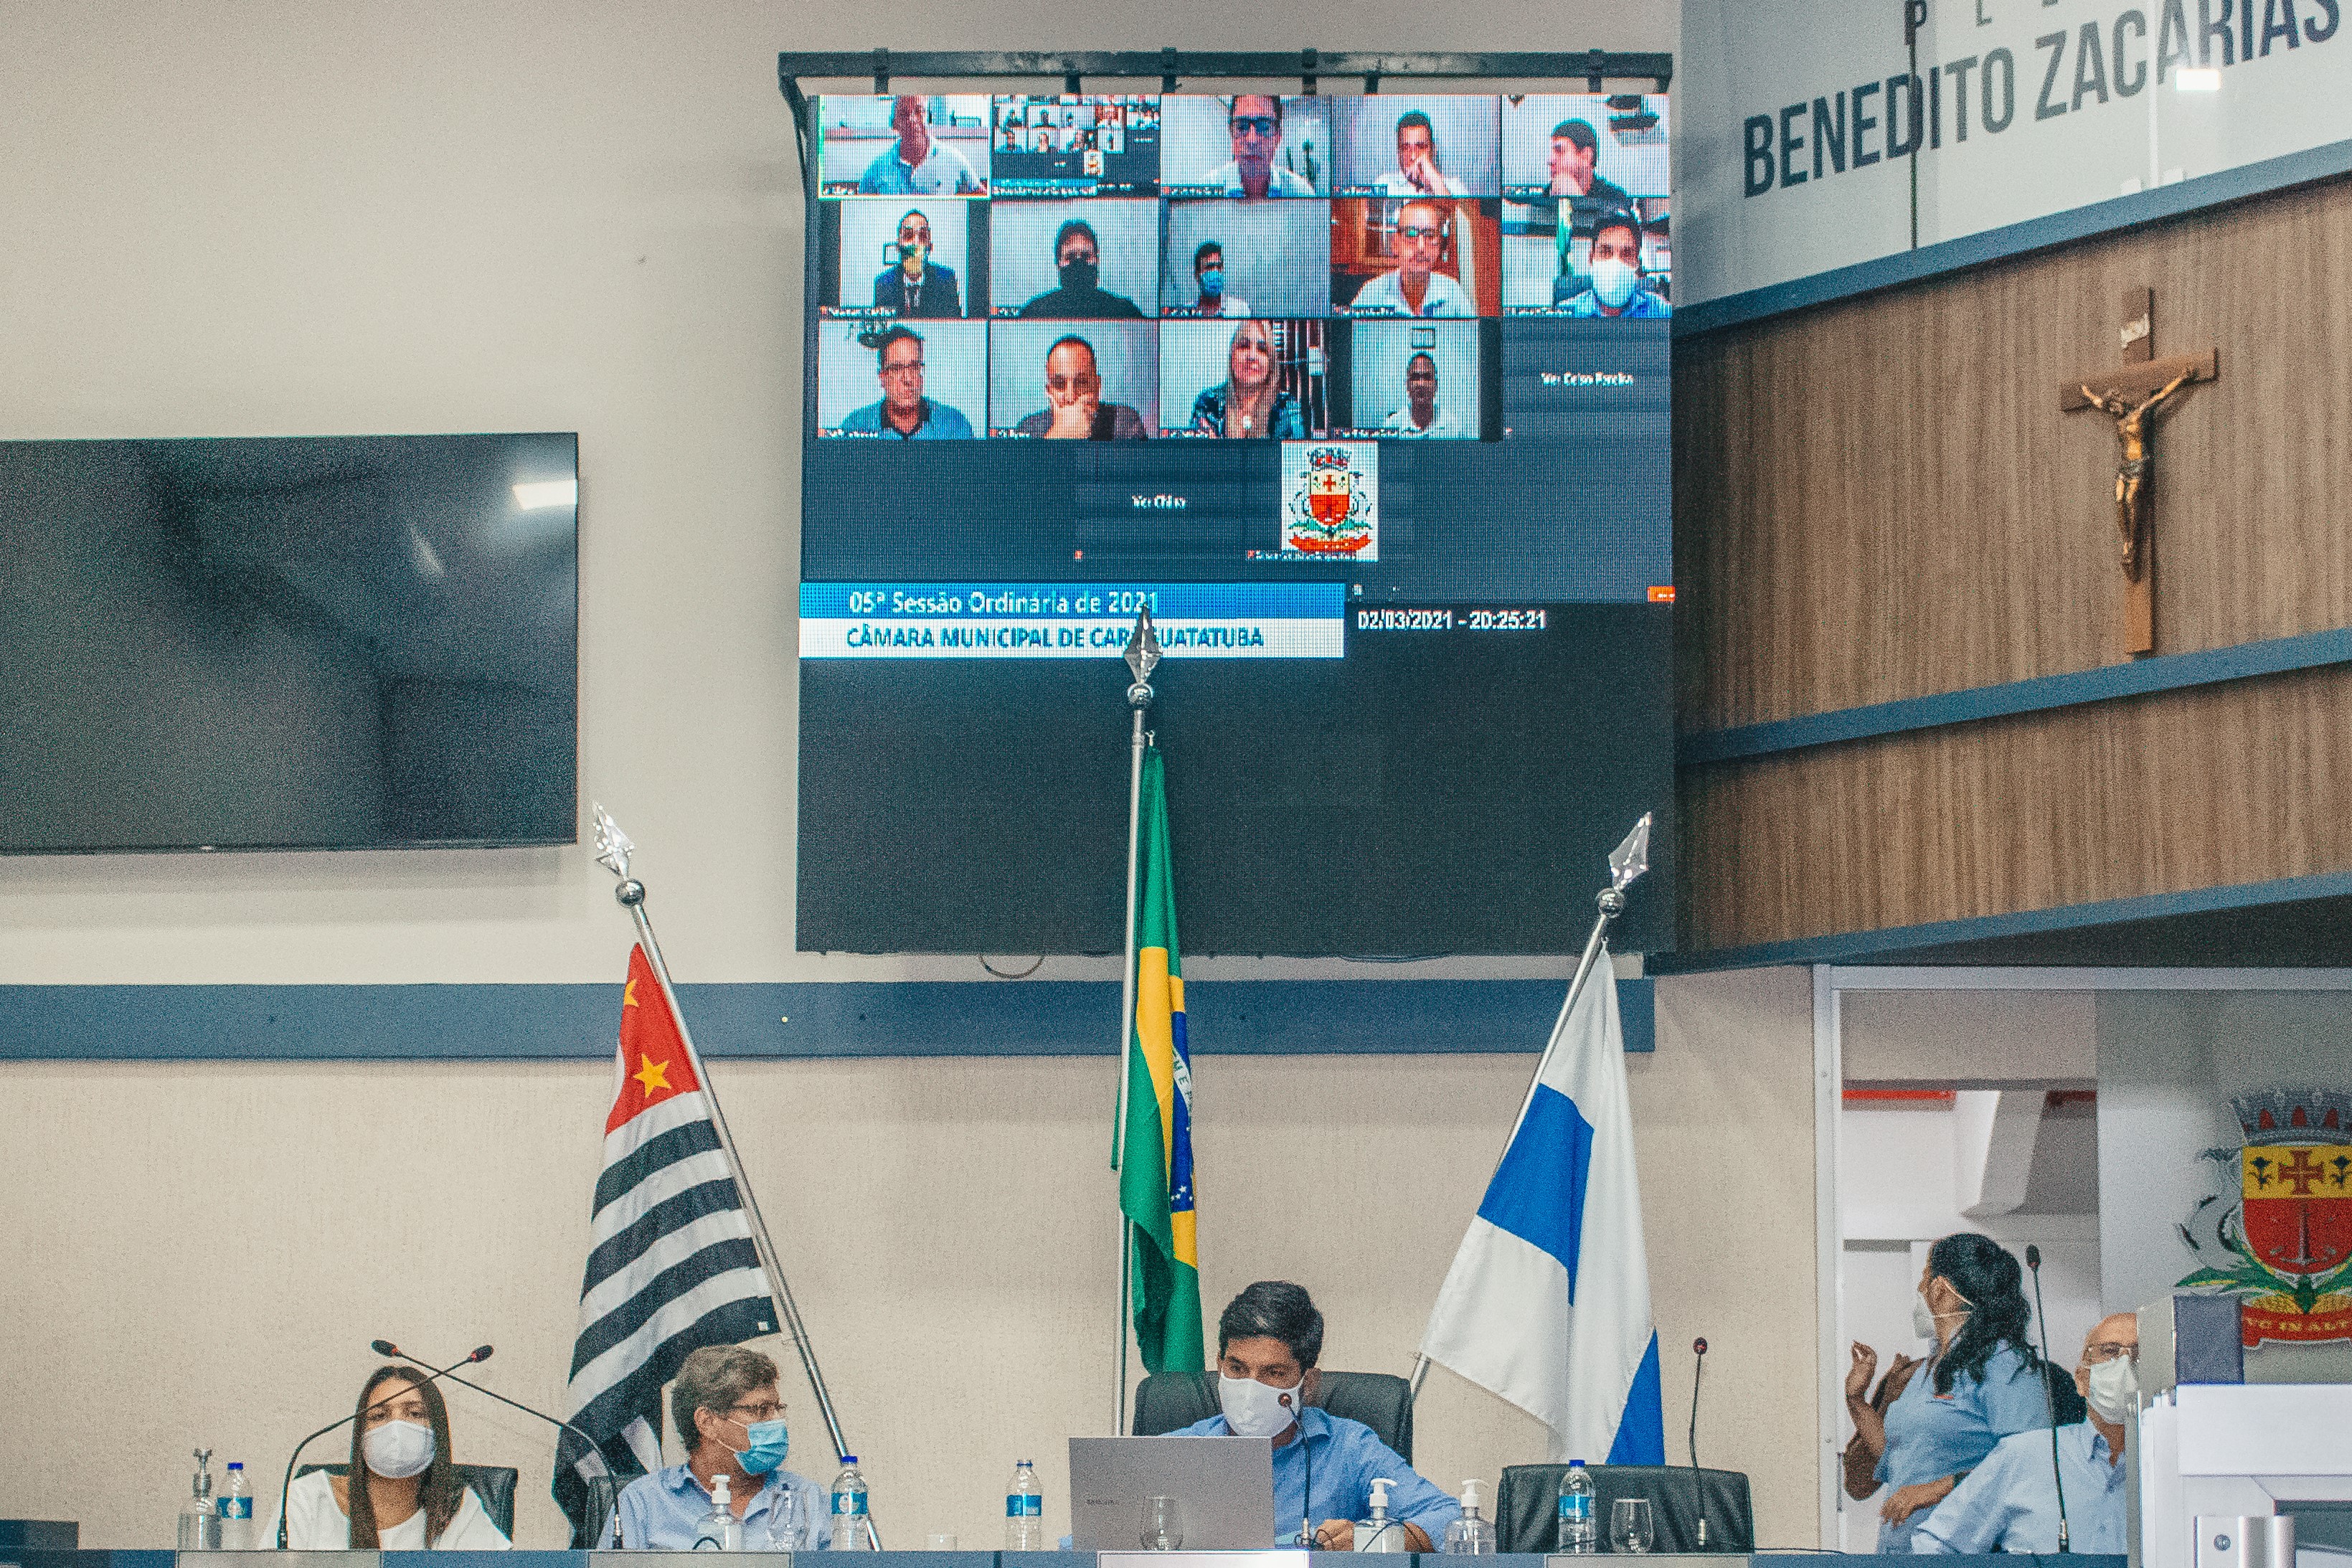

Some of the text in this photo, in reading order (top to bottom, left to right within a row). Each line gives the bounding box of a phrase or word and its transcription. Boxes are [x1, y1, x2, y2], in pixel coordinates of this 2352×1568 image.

[1743, 47, 2015, 199] BENEDITO
[892, 591, 962, 613] Sessão
[970, 590, 1069, 613] Ordinária
[1075, 590, 1101, 613] de
[1108, 591, 1158, 613] 2021
[1358, 609, 1453, 631] 02/03/2021
[1469, 610, 1546, 630] 20:25:21
[847, 623, 1265, 648] CÂMARA MUNICIPAL DE CARUATATUBA
